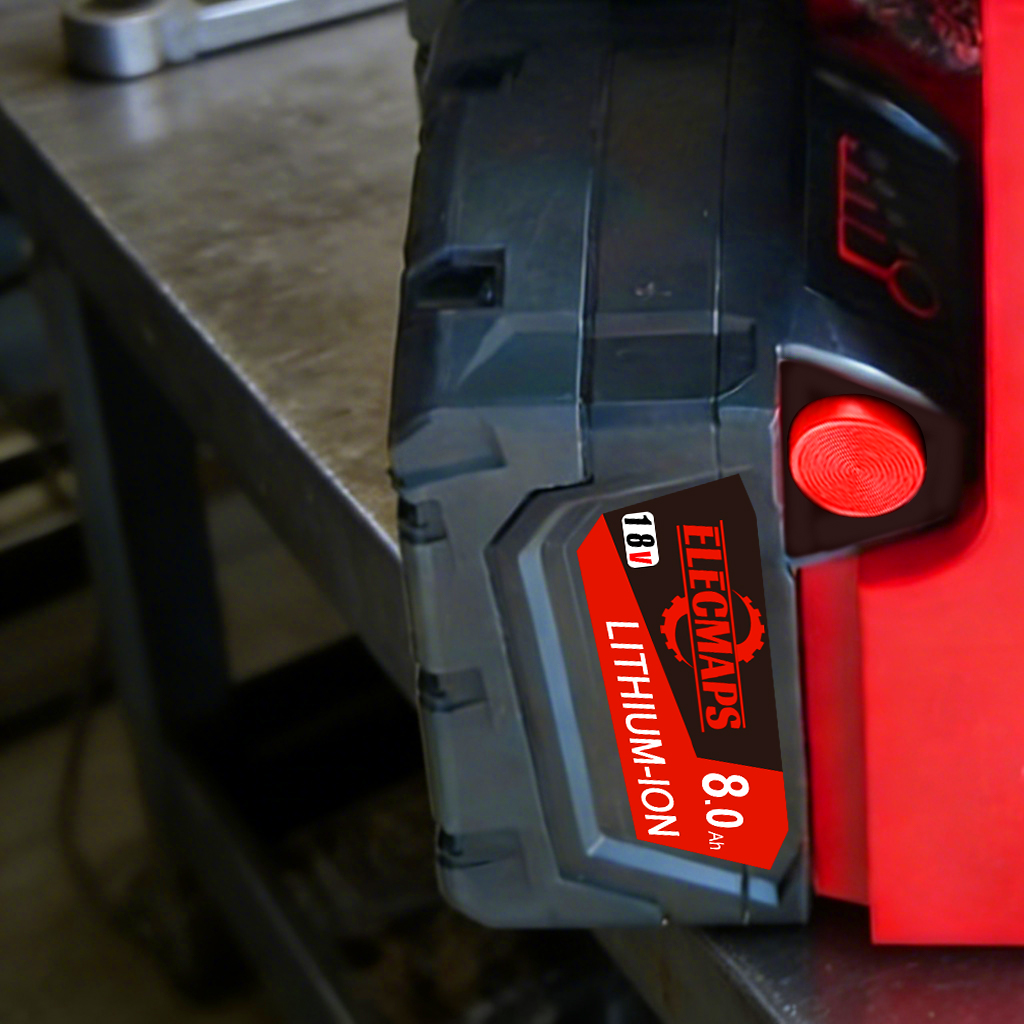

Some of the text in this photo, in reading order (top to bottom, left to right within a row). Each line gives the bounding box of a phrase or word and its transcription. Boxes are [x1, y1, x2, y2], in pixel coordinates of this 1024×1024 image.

[623, 513, 656, 566] 18V
[682, 523, 742, 731] ELECMAPS
[605, 619, 680, 837] LITHIUM-ION
